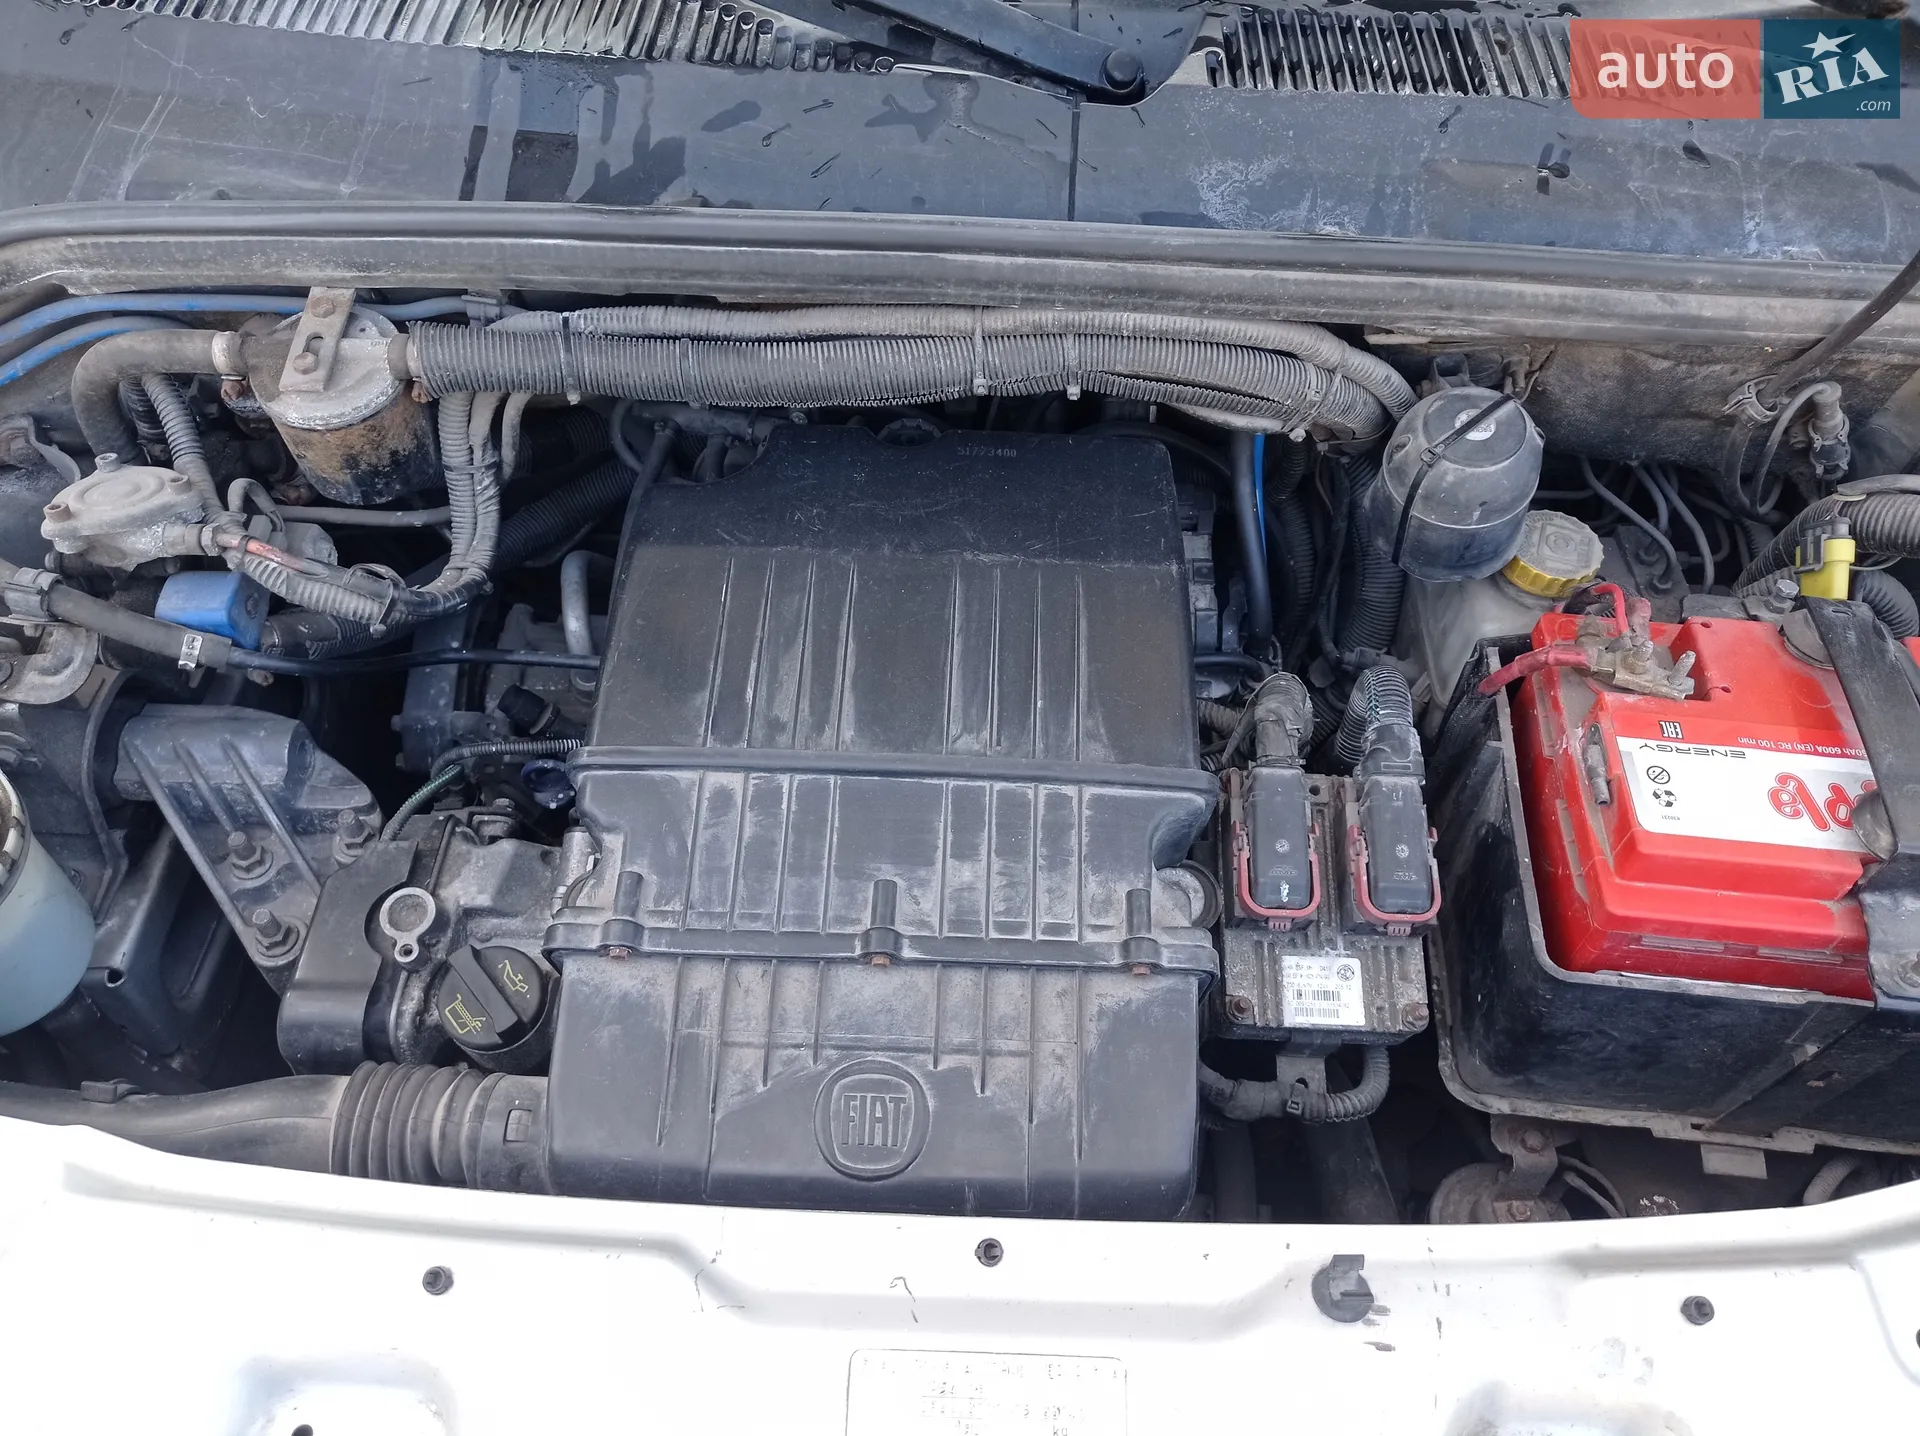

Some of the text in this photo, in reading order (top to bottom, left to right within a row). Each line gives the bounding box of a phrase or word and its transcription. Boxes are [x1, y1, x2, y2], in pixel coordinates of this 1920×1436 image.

[1659, 720, 1684, 739] EAC
[1737, 736, 1757, 745] min
[1758, 739, 1775, 748] 100
[1778, 741, 1792, 750] RC
[1639, 742, 1747, 759] ENERGY
[1793, 742, 1814, 753] (EN)
[1815, 745, 1841, 755] 600A
[841, 1093, 909, 1148] FIAT
